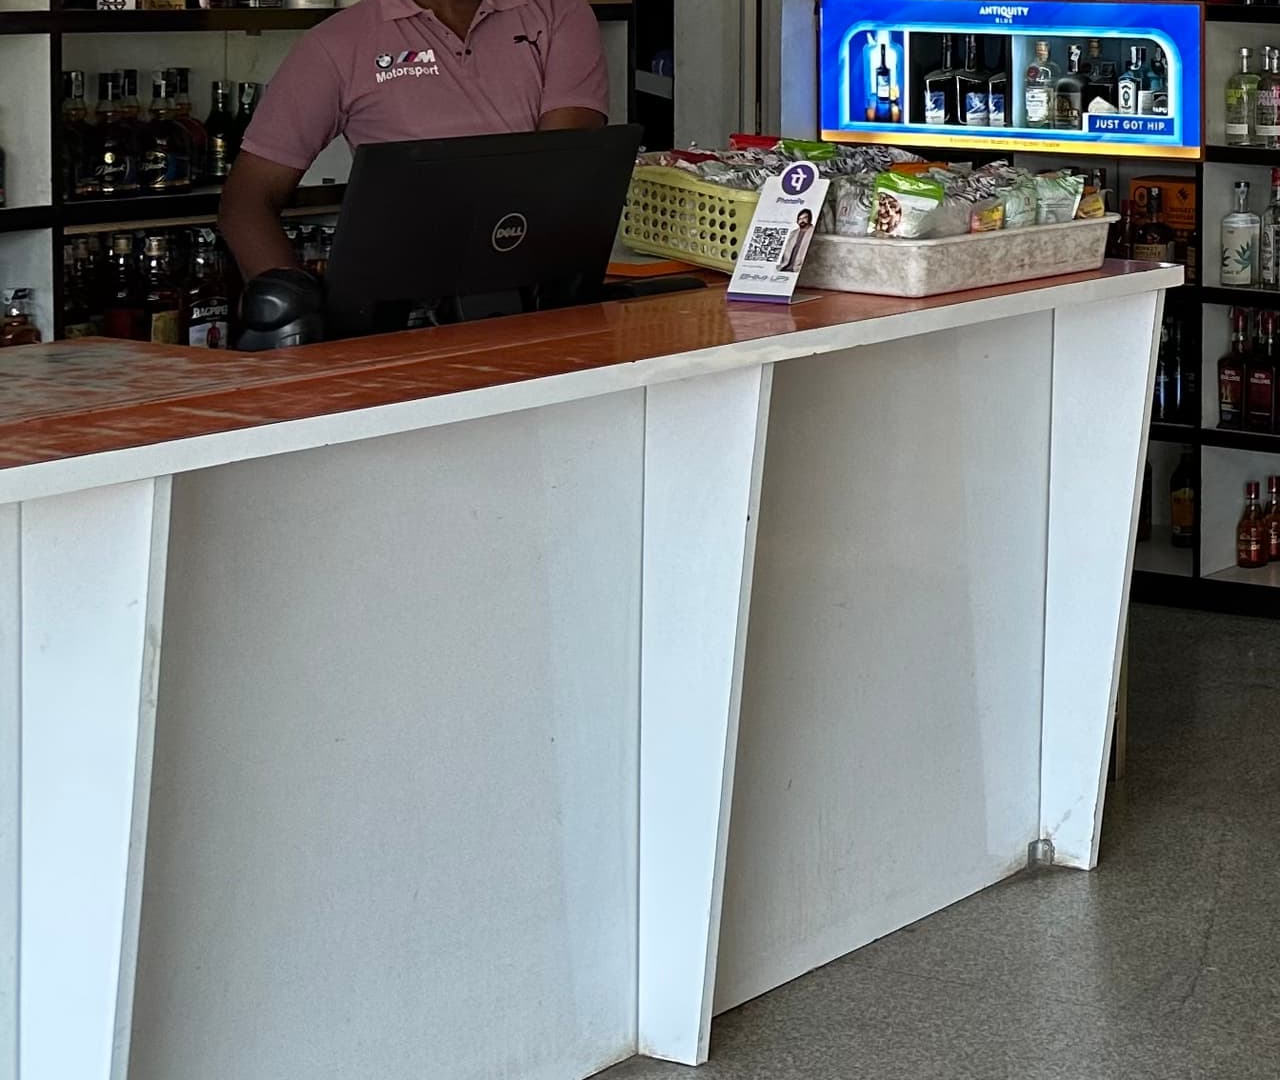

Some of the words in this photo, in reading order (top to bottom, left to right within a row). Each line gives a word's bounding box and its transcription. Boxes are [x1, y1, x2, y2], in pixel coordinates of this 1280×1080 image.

[979, 5, 1029, 18] ANTIQUITY
[376, 65, 439, 83] Motorsport
[1095, 119, 1118, 130] JUST
[1122, 120, 1142, 130] GOT
[496, 226, 523, 239] DELL
